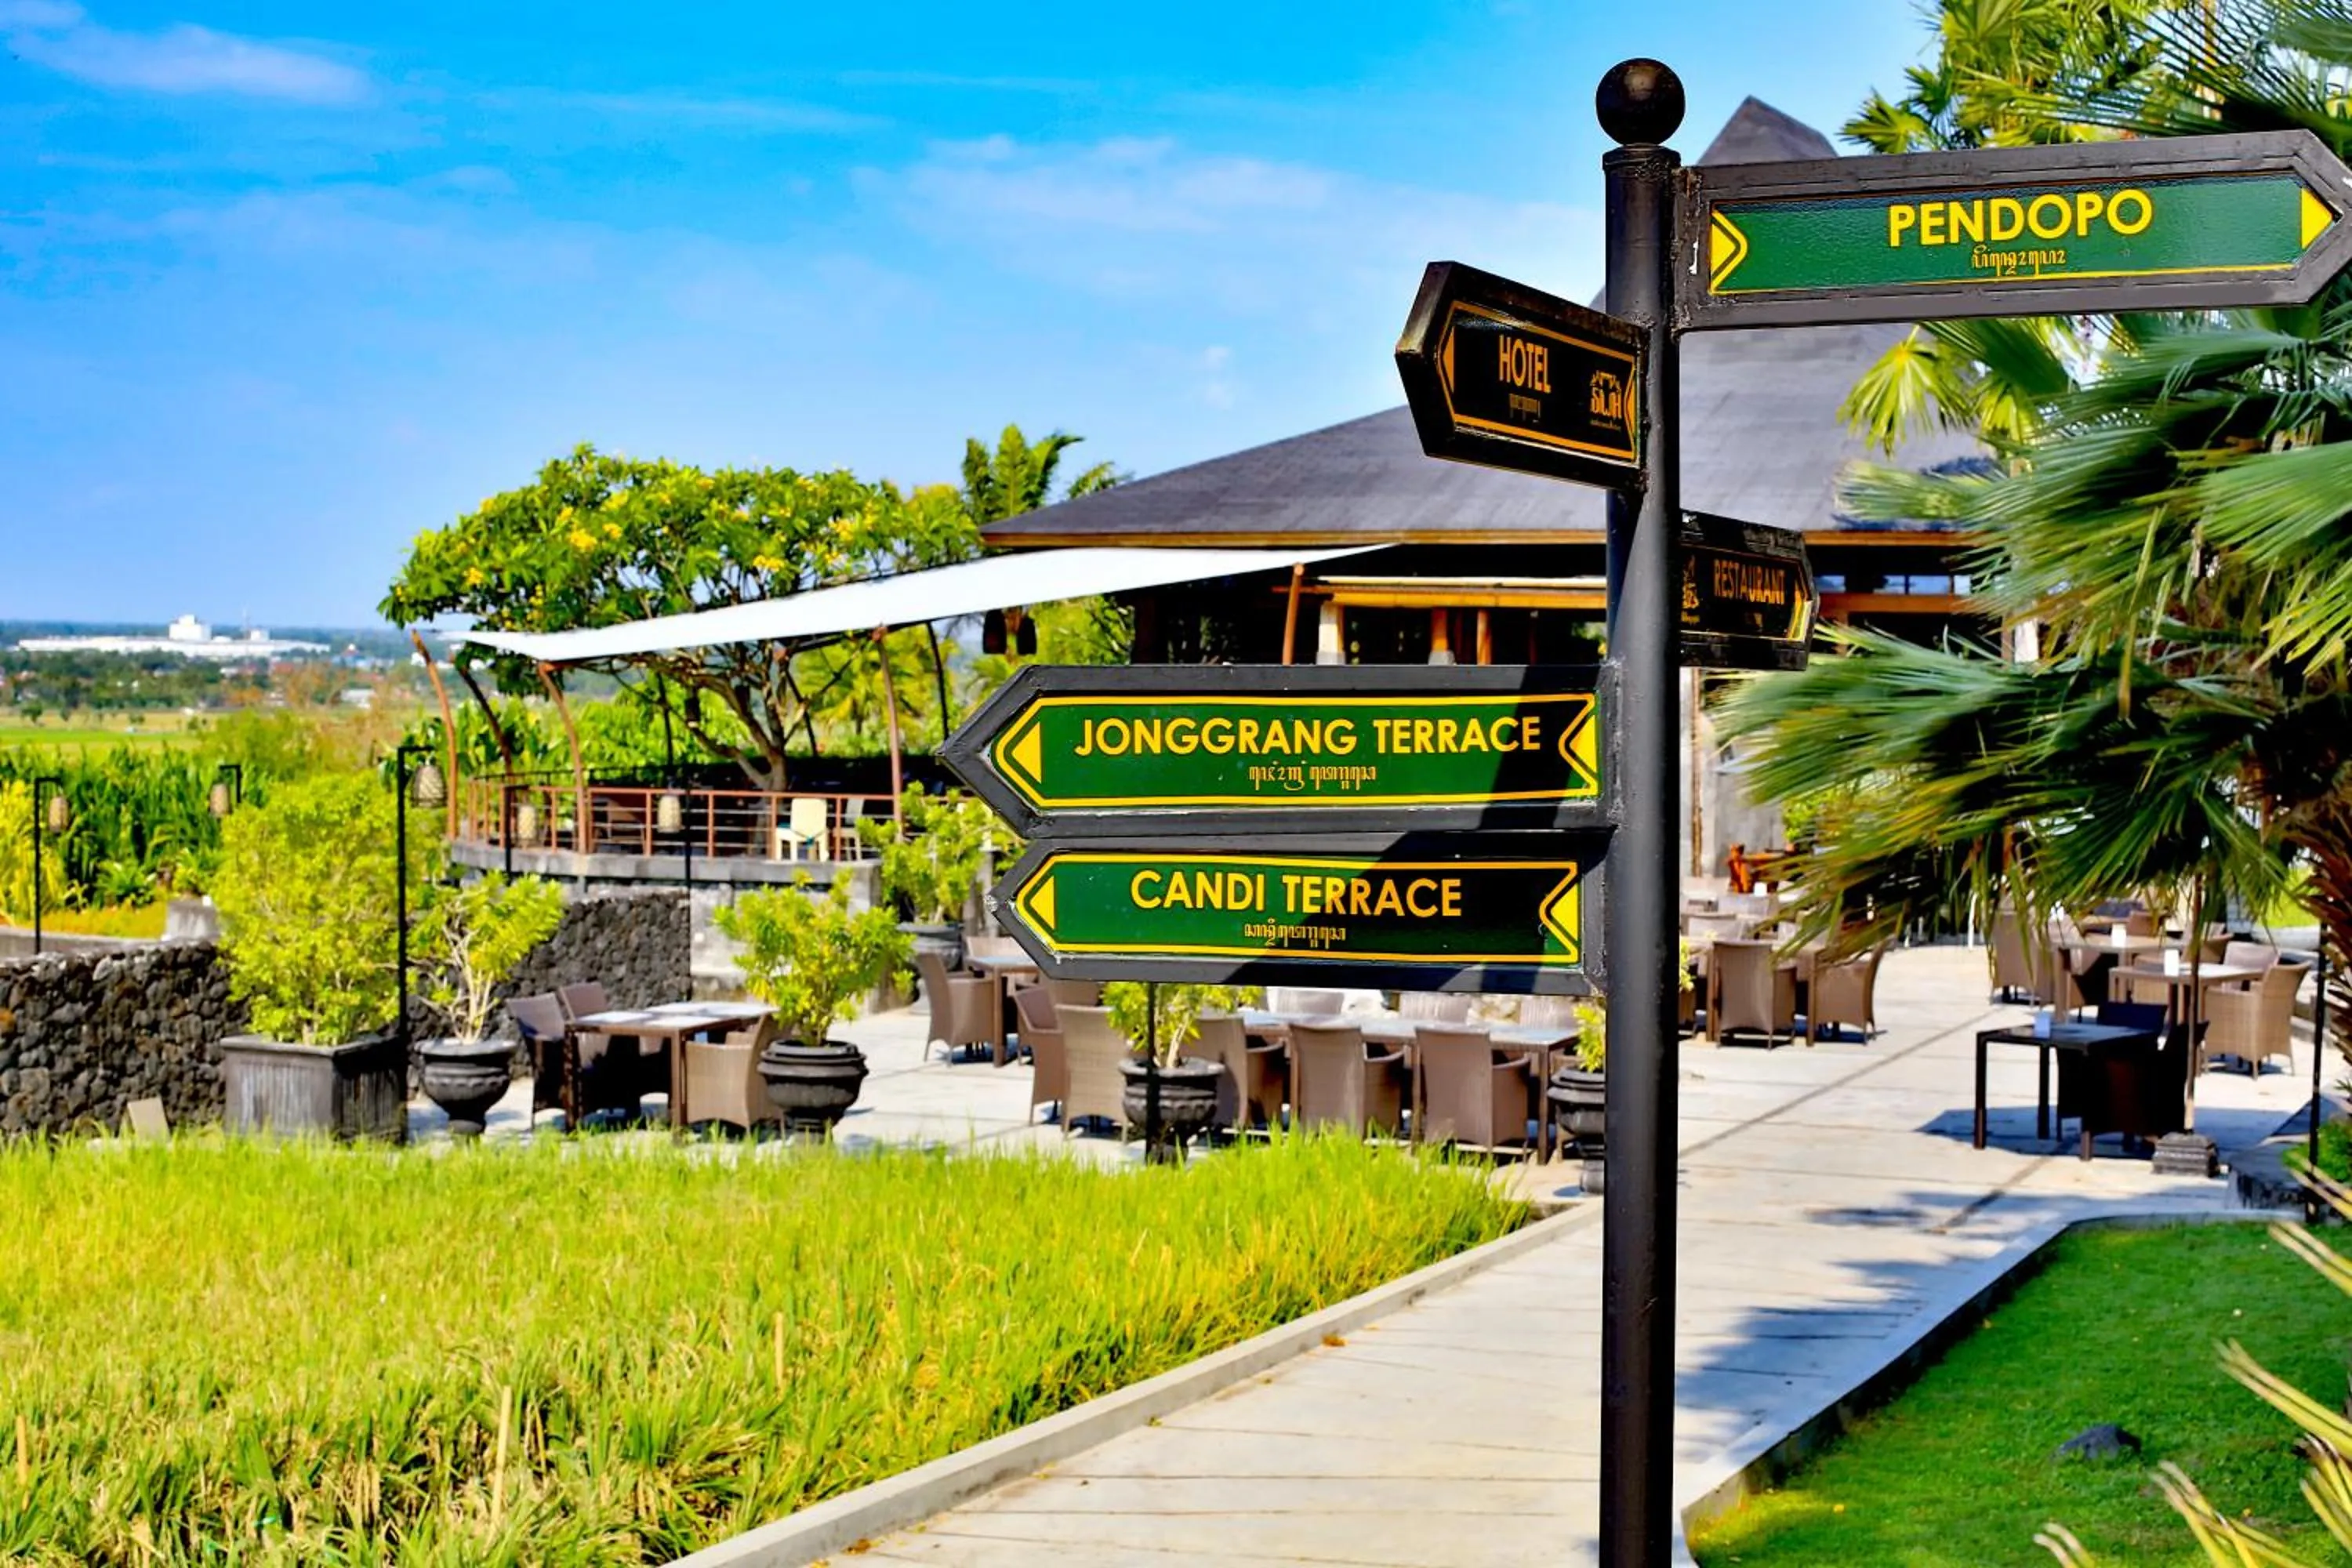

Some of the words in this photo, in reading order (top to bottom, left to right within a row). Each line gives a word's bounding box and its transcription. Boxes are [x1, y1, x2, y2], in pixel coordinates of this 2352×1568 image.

[1889, 189, 2153, 247] PENDOPO
[1498, 334, 1552, 394] HOTEL
[1714, 559, 1785, 605] RESTAURANT
[1074, 717, 1358, 757] JONGGRANG
[1372, 716, 1541, 754] TERRACE
[1130, 869, 1265, 911] CANDI
[1281, 875, 1462, 917] TERRACE
